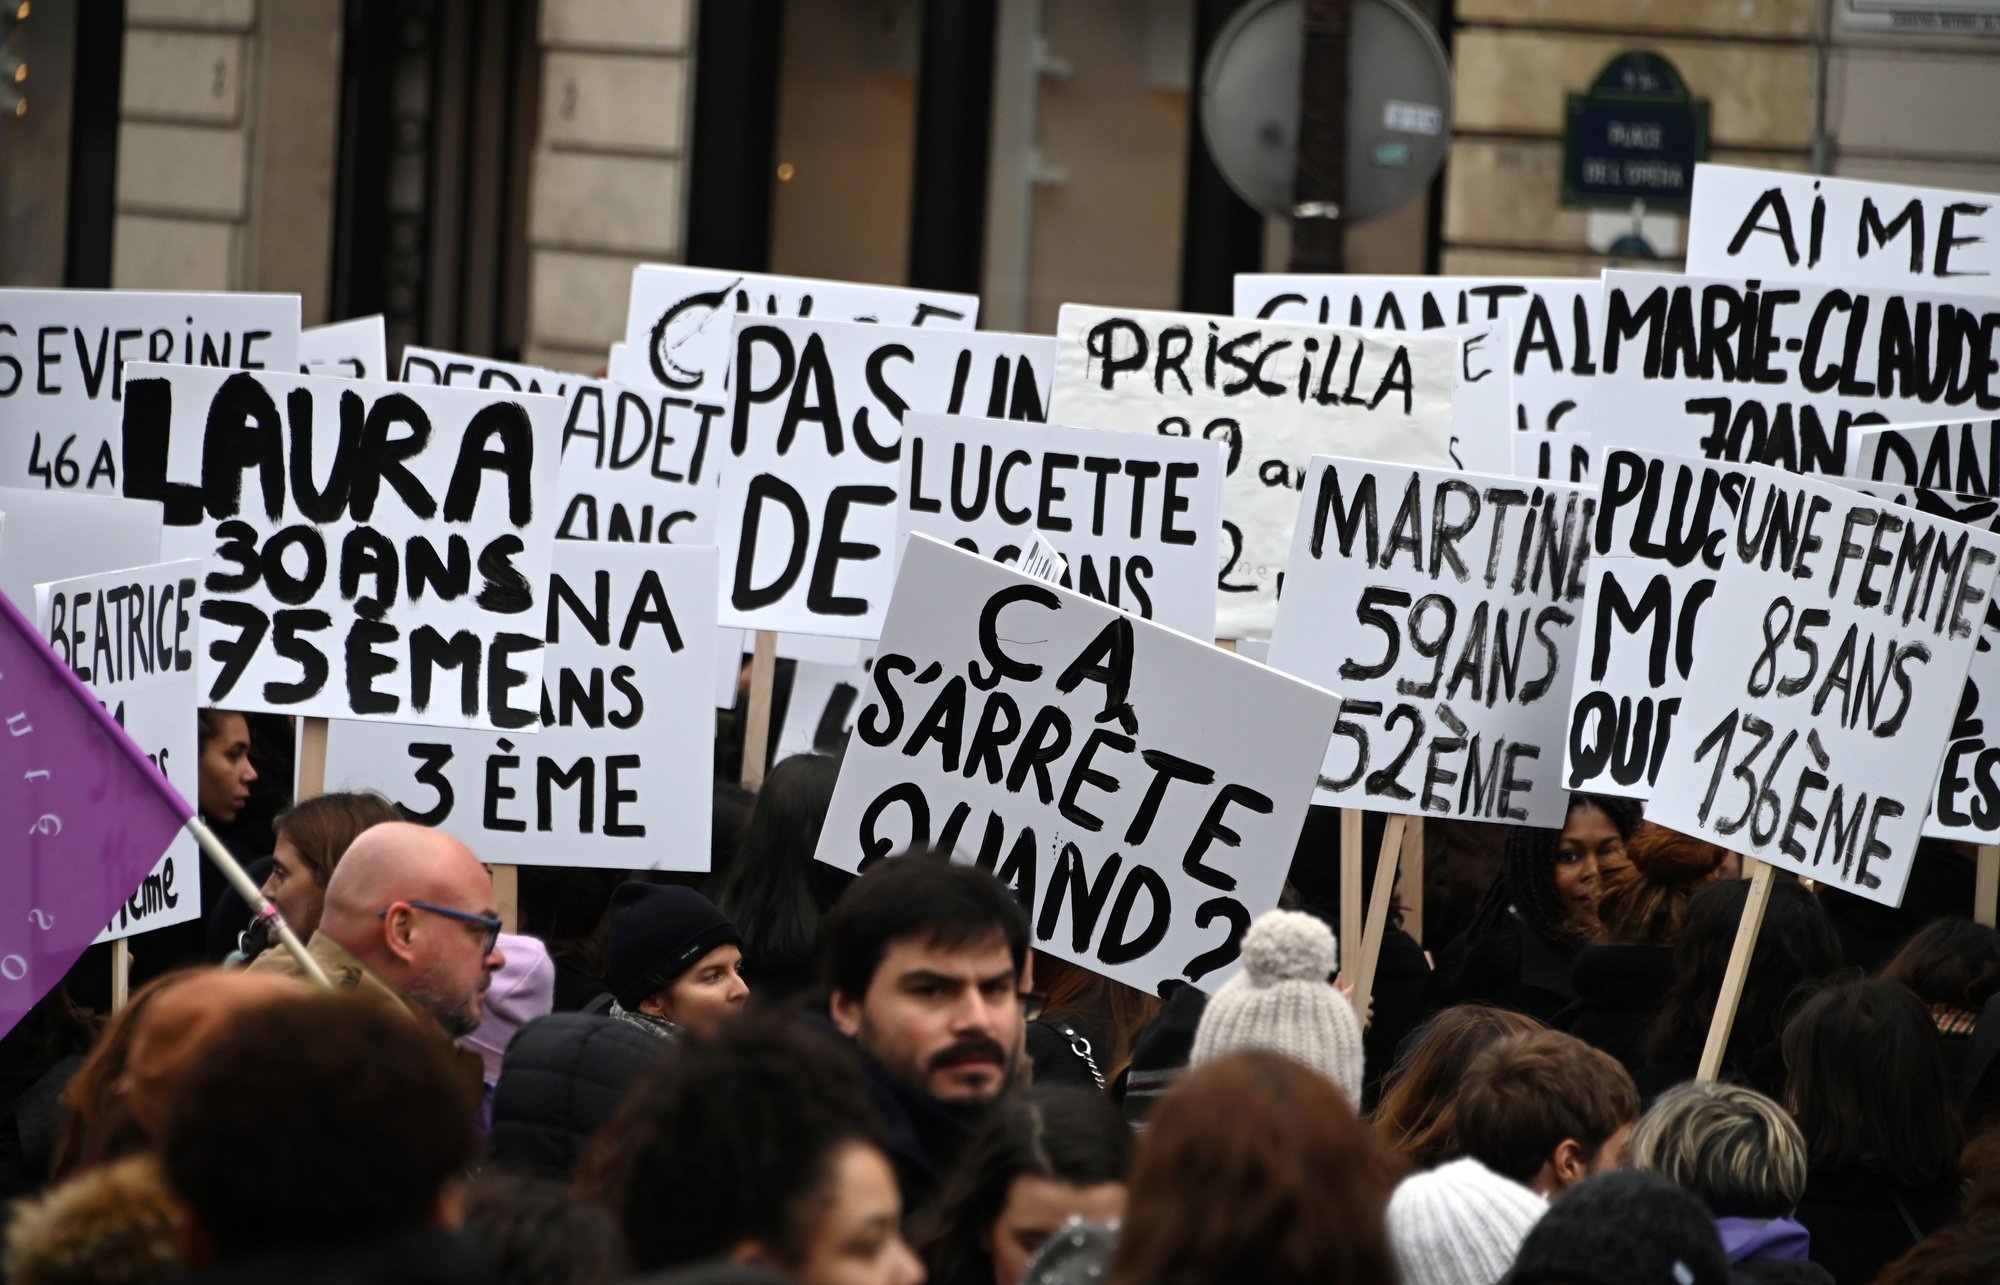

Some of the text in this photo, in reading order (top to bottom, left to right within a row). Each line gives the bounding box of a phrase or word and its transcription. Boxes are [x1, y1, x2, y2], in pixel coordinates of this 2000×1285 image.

[122, 372, 533, 528] LAURA
[731, 325, 914, 463] PAS
[731, 474, 897, 616] DE
[910, 437, 1199, 546] LUCETTE
[1737, 476, 1997, 641] UNE FEMME
[50, 578, 197, 687] BEATRICE
[968, 584, 1134, 708] ÇA
[484, 738, 646, 838] ÈME
[857, 653, 1274, 892] S'ARRÊTE
